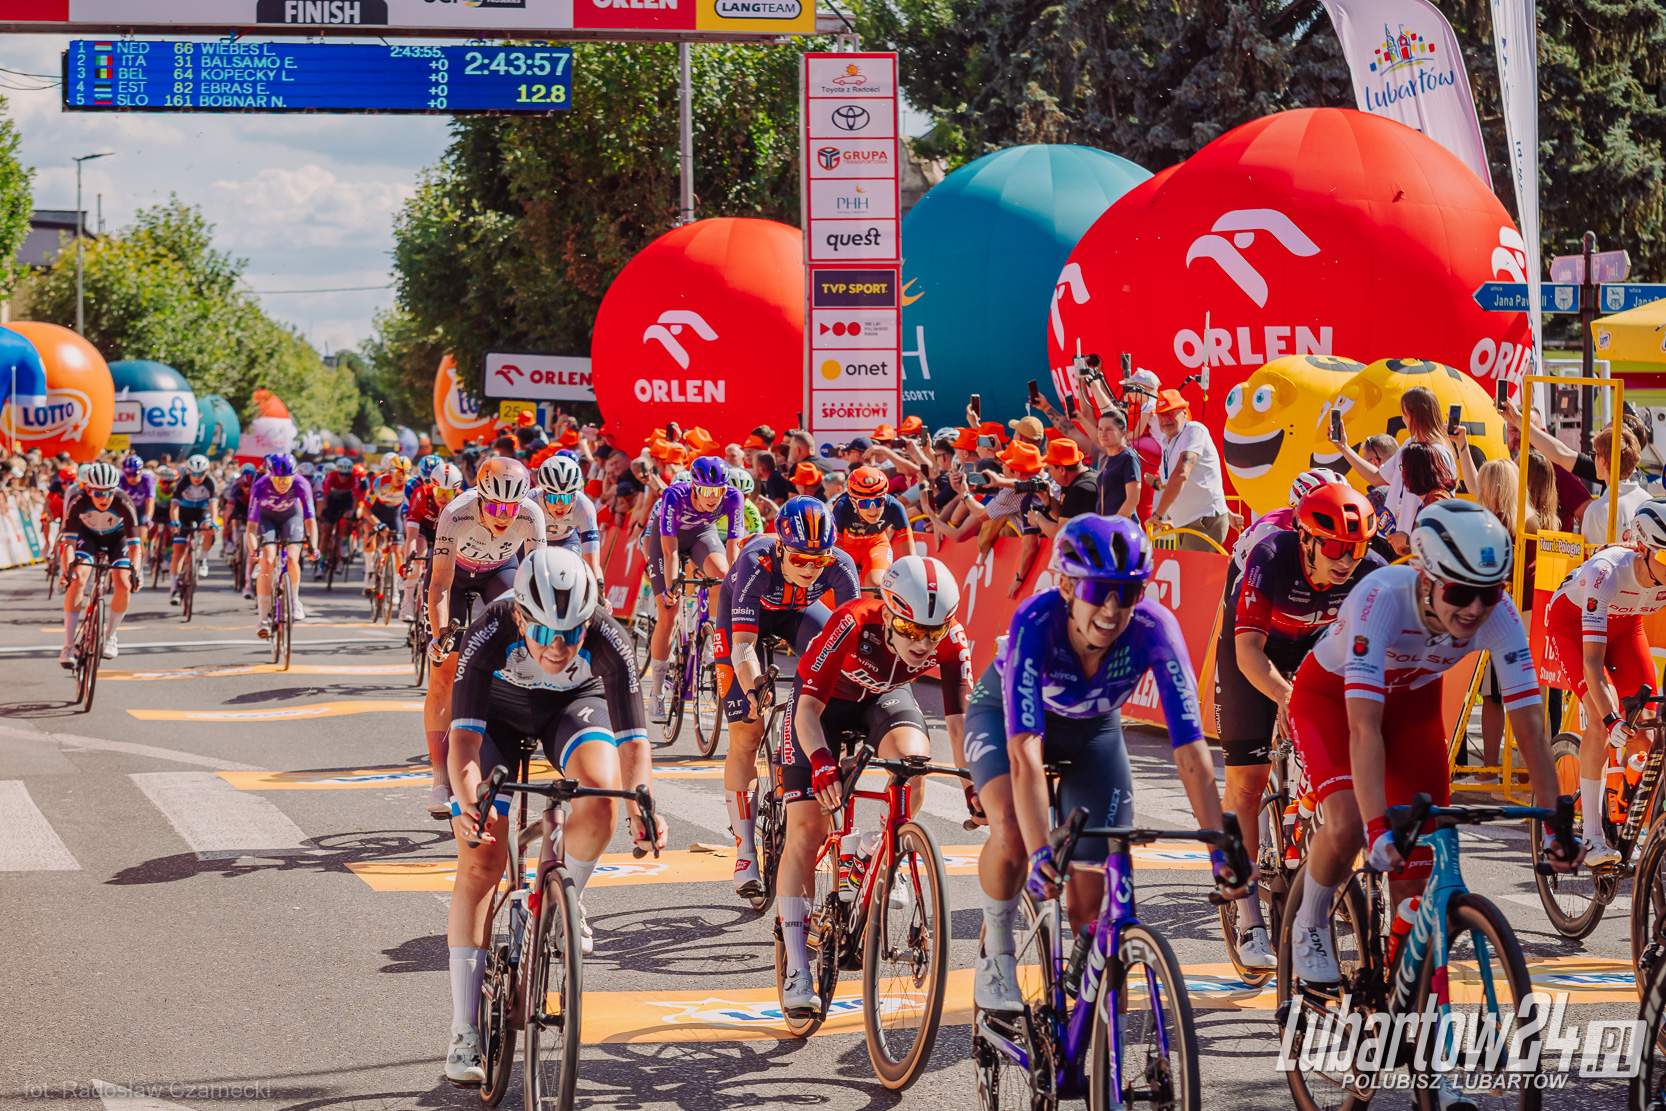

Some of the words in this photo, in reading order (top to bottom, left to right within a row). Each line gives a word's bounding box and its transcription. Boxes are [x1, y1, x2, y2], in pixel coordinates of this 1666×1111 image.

[285, 1, 360, 23] FINISH
[722, 2, 796, 13] LANGTEAM
[117, 42, 149, 53] NED
[174, 43, 193, 53] 66
[201, 43, 260, 55] WIEBES
[77, 55, 86, 65] 2
[122, 55, 146, 66] ITA
[174, 56, 192, 67] 31
[201, 56, 281, 68] BALSAMO
[285, 57, 298, 68] E.
[429, 59, 448, 71] +0
[464, 51, 570, 76] 2:43:57
[78, 67, 86, 78] 3
[118, 68, 147, 79] BEL
[173, 69, 193, 79] 64
[201, 69, 276, 81] KOPECKY
[429, 72, 448, 83] +0
[76, 81, 85, 91] 4
[118, 81, 146, 92] EST
[173, 82, 193, 93] 82
[201, 83, 253, 94] EBRAS
[428, 86, 448, 97] +0
[516, 84, 566, 103] 12.8
[821, 86, 845, 94] Toyota
[117, 94, 148, 106] SLO
[165, 95, 192, 106] 161
[200, 96, 266, 107] BOBNAR
[427, 98, 447, 109] +0
[843, 151, 888, 160] GRUPA
[837, 197, 868, 208] PHH
[826, 227, 881, 251] quest
[821, 283, 847, 294] TVP
[1494, 293, 1513, 307] Jana
[1173, 325, 1334, 369] ORLEN
[845, 361, 888, 376] onet
[529, 369, 593, 387] ORLEN
[634, 378, 725, 403] ORLEN
[22, 402, 75, 427] LOTTO
[143, 396, 187, 428] est
[822, 407, 888, 418] SPORTOWY
[1018, 657, 1039, 728] Jayco
[1166, 660, 1200, 728] Jayco
[1622, 752, 1663, 841] CANYON
